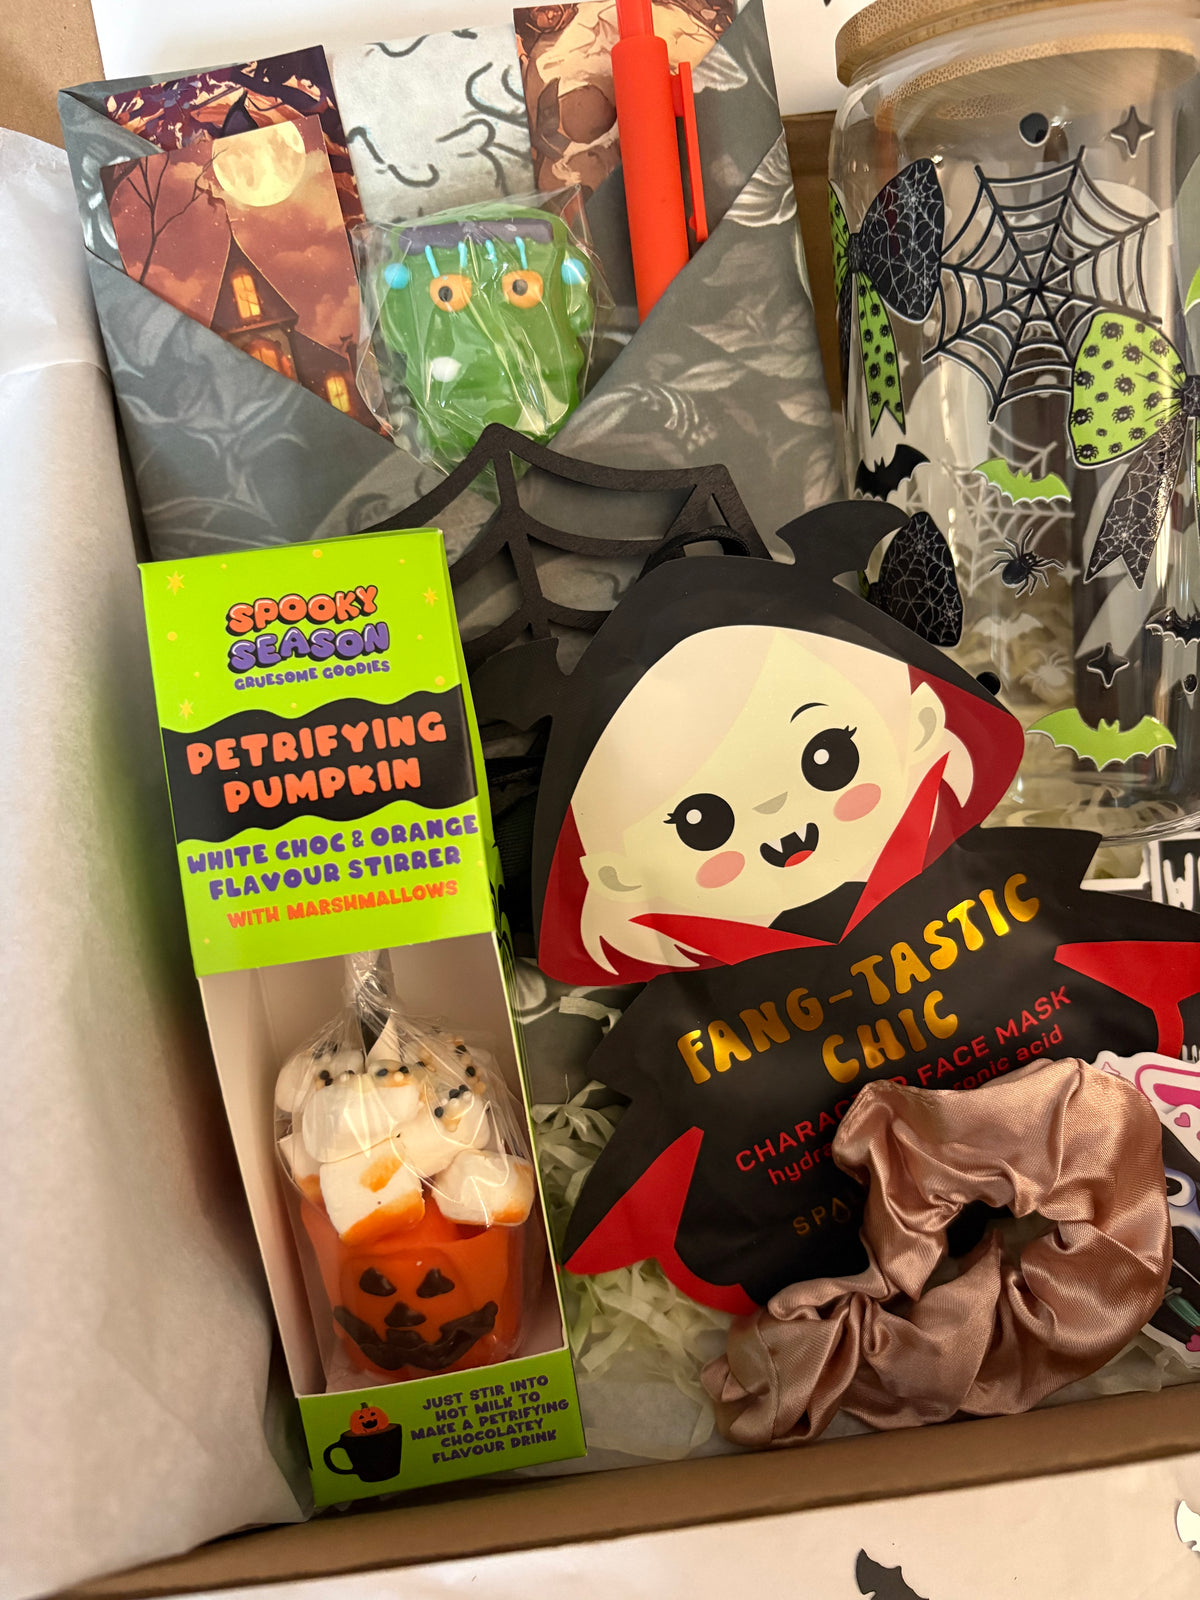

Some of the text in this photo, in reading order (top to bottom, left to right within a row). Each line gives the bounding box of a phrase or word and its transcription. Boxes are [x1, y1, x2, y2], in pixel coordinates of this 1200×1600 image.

[226, 585, 379, 637] SPOOKY
[227, 621, 390, 673] SEASON
[234, 659, 390, 691] GRUESOME GOODIES
[185, 710, 447, 775] PETRIFYING
[222, 756, 422, 814] PUMPKIN
[186, 814, 479, 875] WHITE CHOC & ORANGE
[208, 845, 461, 901] FLAVOUR STIRRER
[227, 879, 459, 929] WITH MARSHMALLOWS
[676, 873, 1041, 1085] FANG-TASTIC
[821, 990, 959, 1084] CHIC
[917, 1035, 990, 1087] FACE
[994, 985, 1071, 1046] MASK
[1015, 1023, 1064, 1062] acid
[422, 1374, 549, 1410] JUST STIR INTO
[435, 1391, 540, 1422] HOT MILK TO
[410, 1399, 569, 1441] MAKE A PETRIFYING
[440, 1417, 544, 1448] CHOCOLATEY
[432, 1429, 557, 1464] FLAVOUR DRINK
